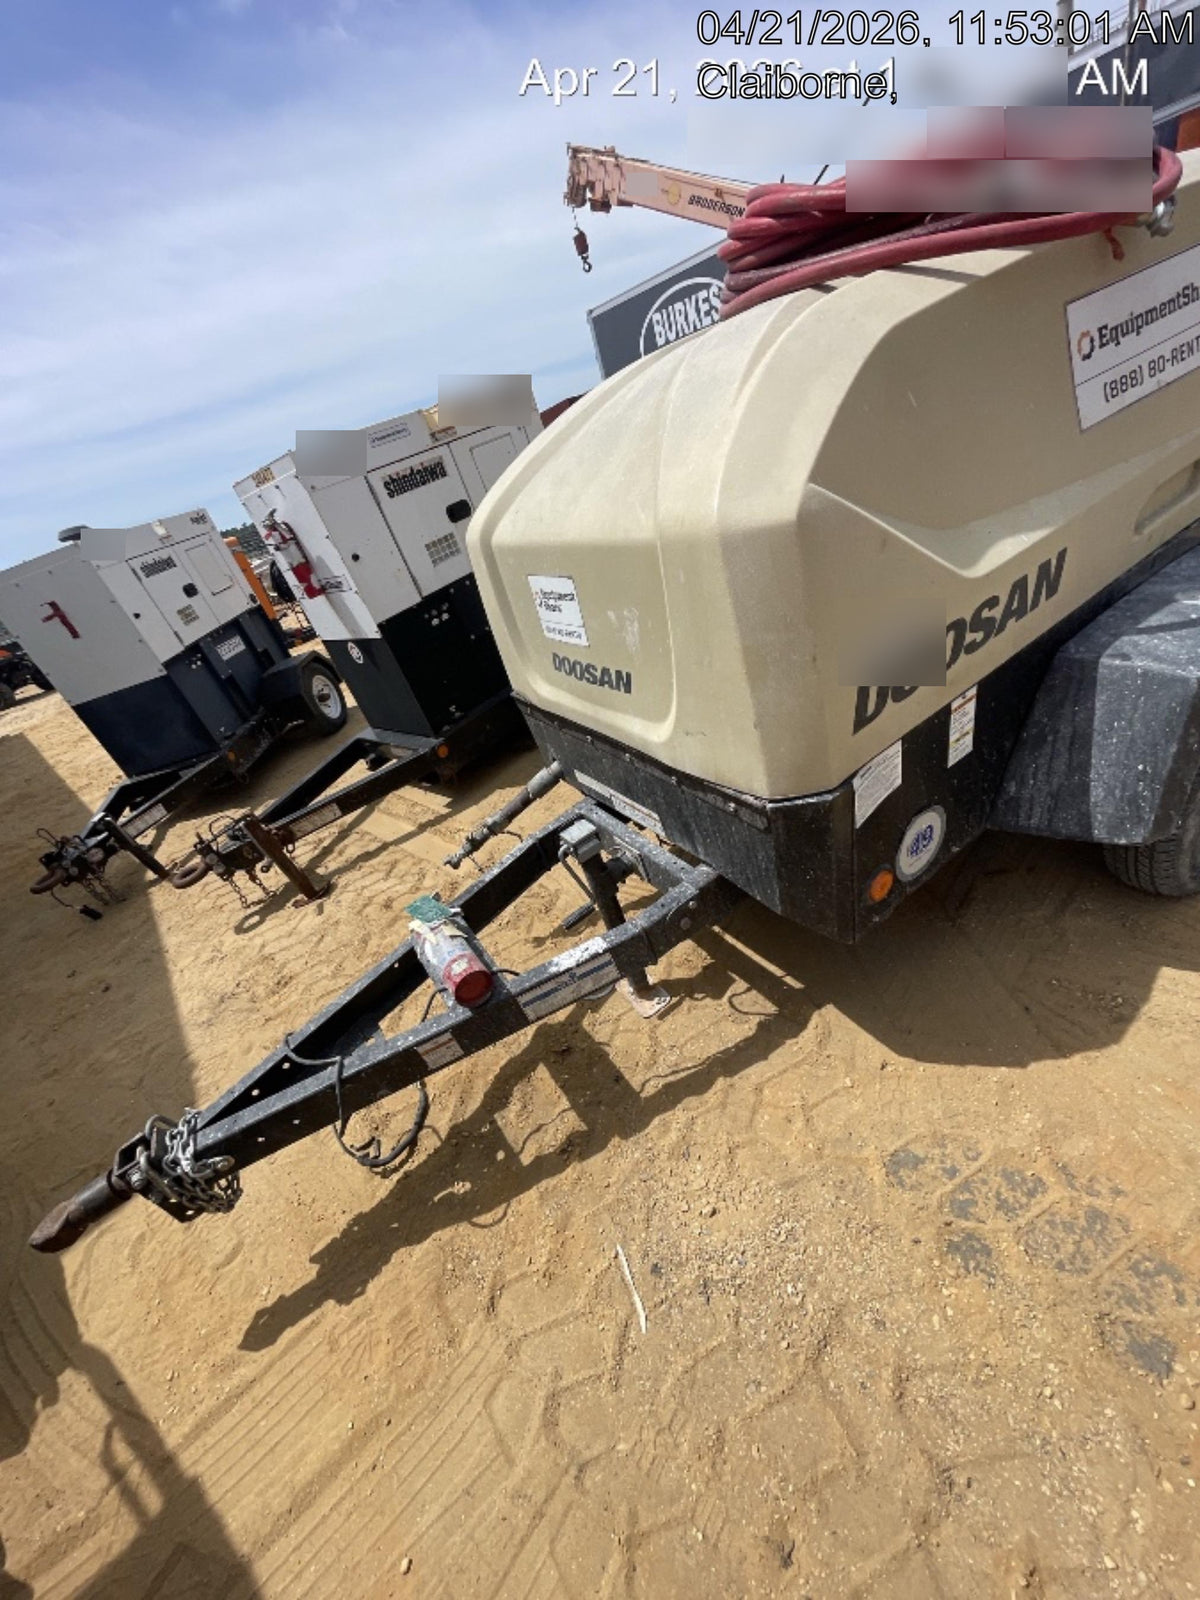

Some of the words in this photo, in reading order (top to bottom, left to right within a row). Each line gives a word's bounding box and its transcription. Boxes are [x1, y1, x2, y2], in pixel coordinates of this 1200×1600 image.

[1097, 282, 1200, 349] EquipmentSh
[1103, 364, 1144, 403] (888)
[553, 652, 632, 694] DOOSAN
